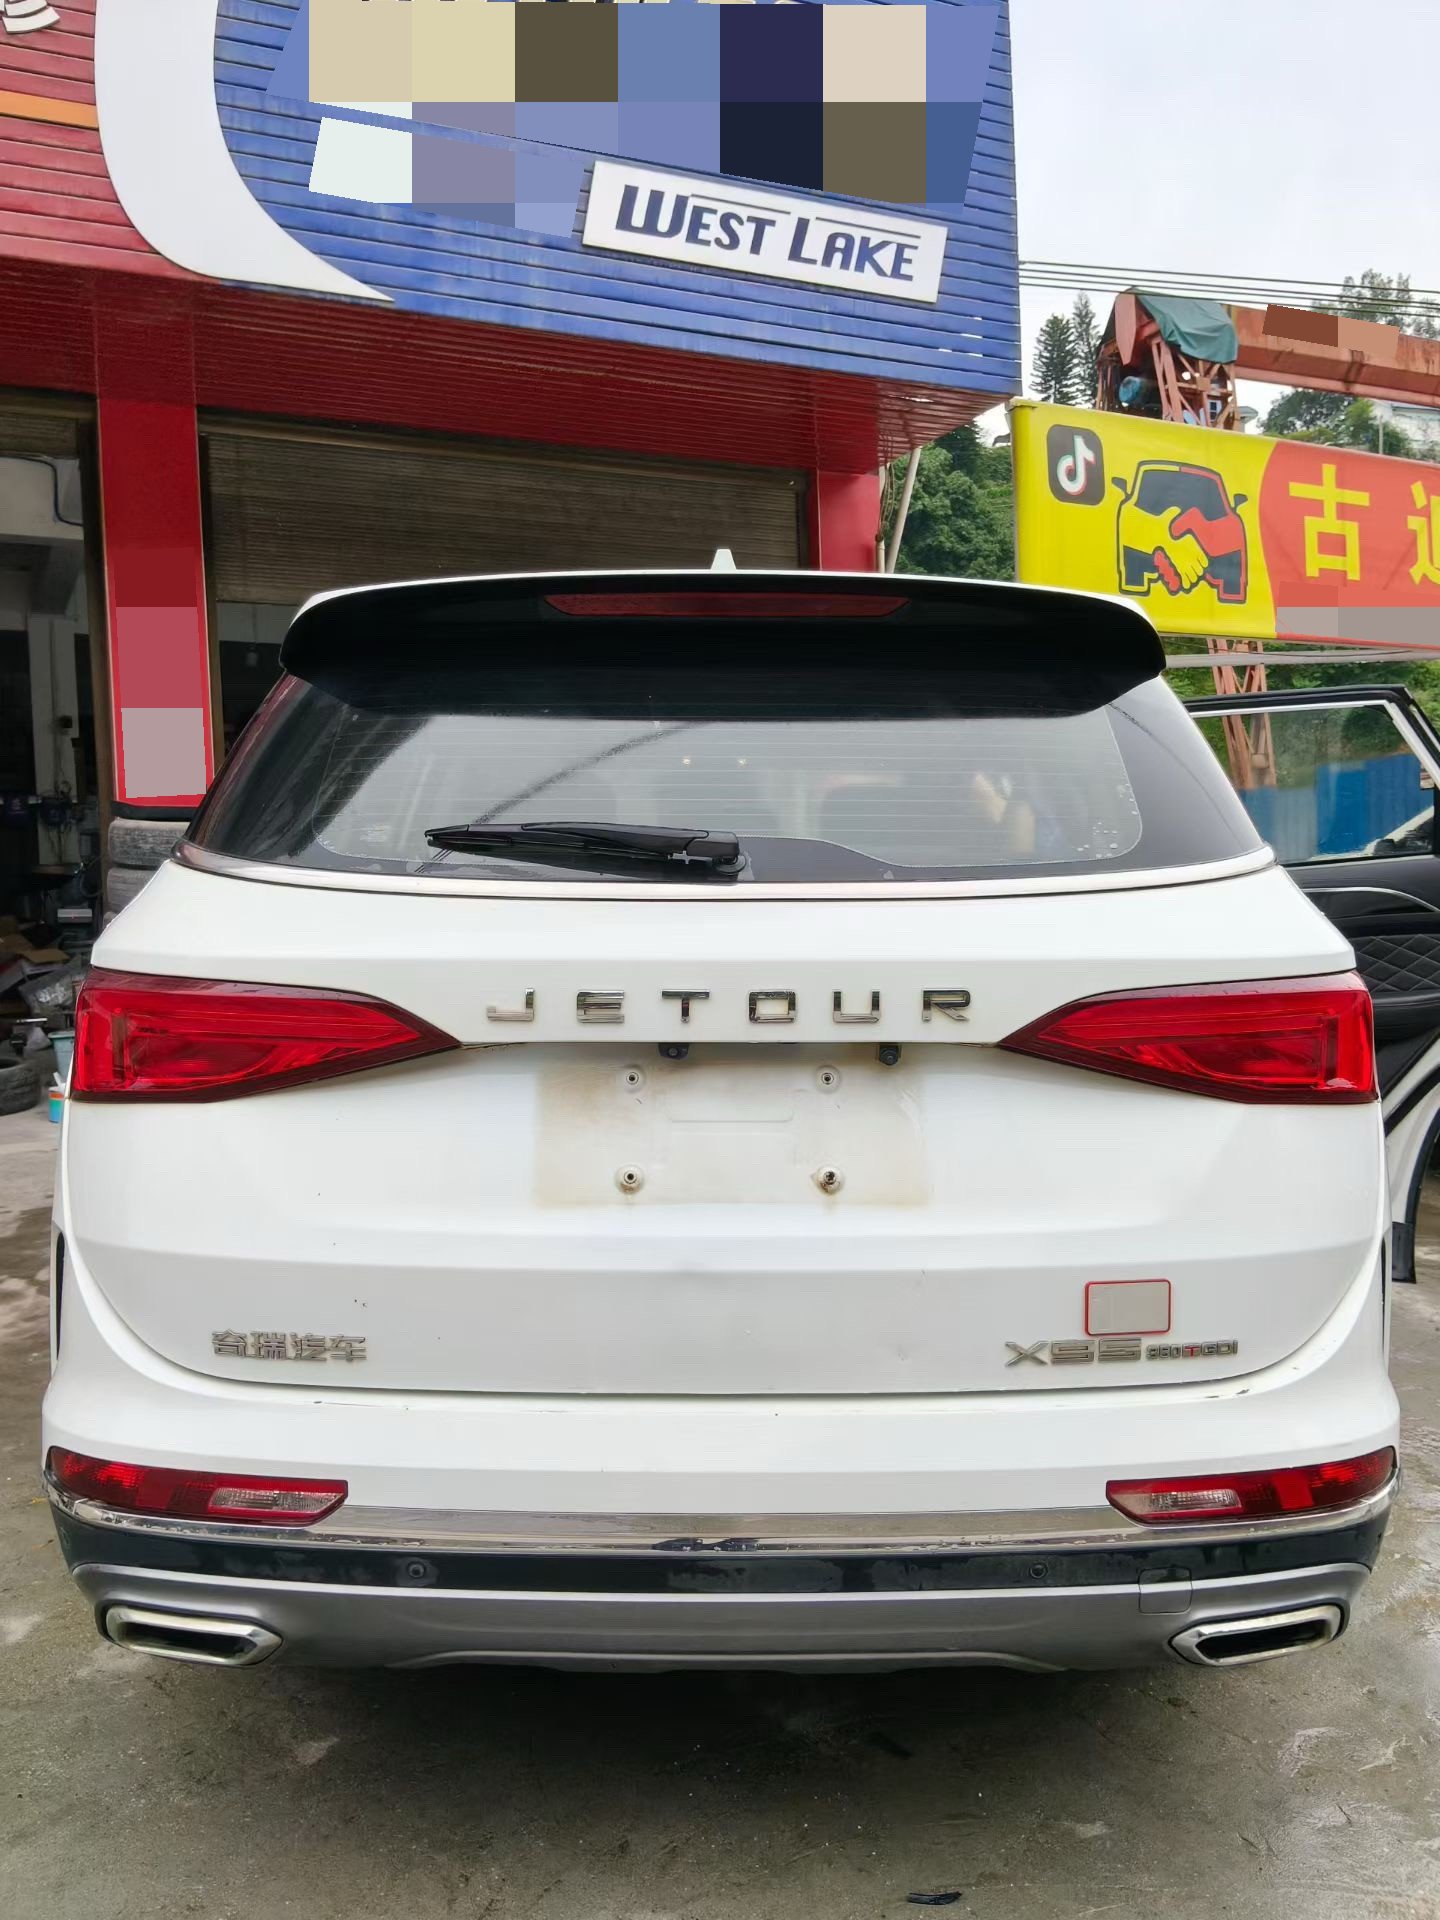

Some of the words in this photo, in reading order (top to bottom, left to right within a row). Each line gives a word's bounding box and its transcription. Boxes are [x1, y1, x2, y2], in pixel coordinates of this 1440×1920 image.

[615, 184, 776, 256] WEST
[788, 217, 918, 283] LAKE
[486, 987, 971, 1024] JETOUR
[211, 1329, 367, 1362] 奇瑞汽车
